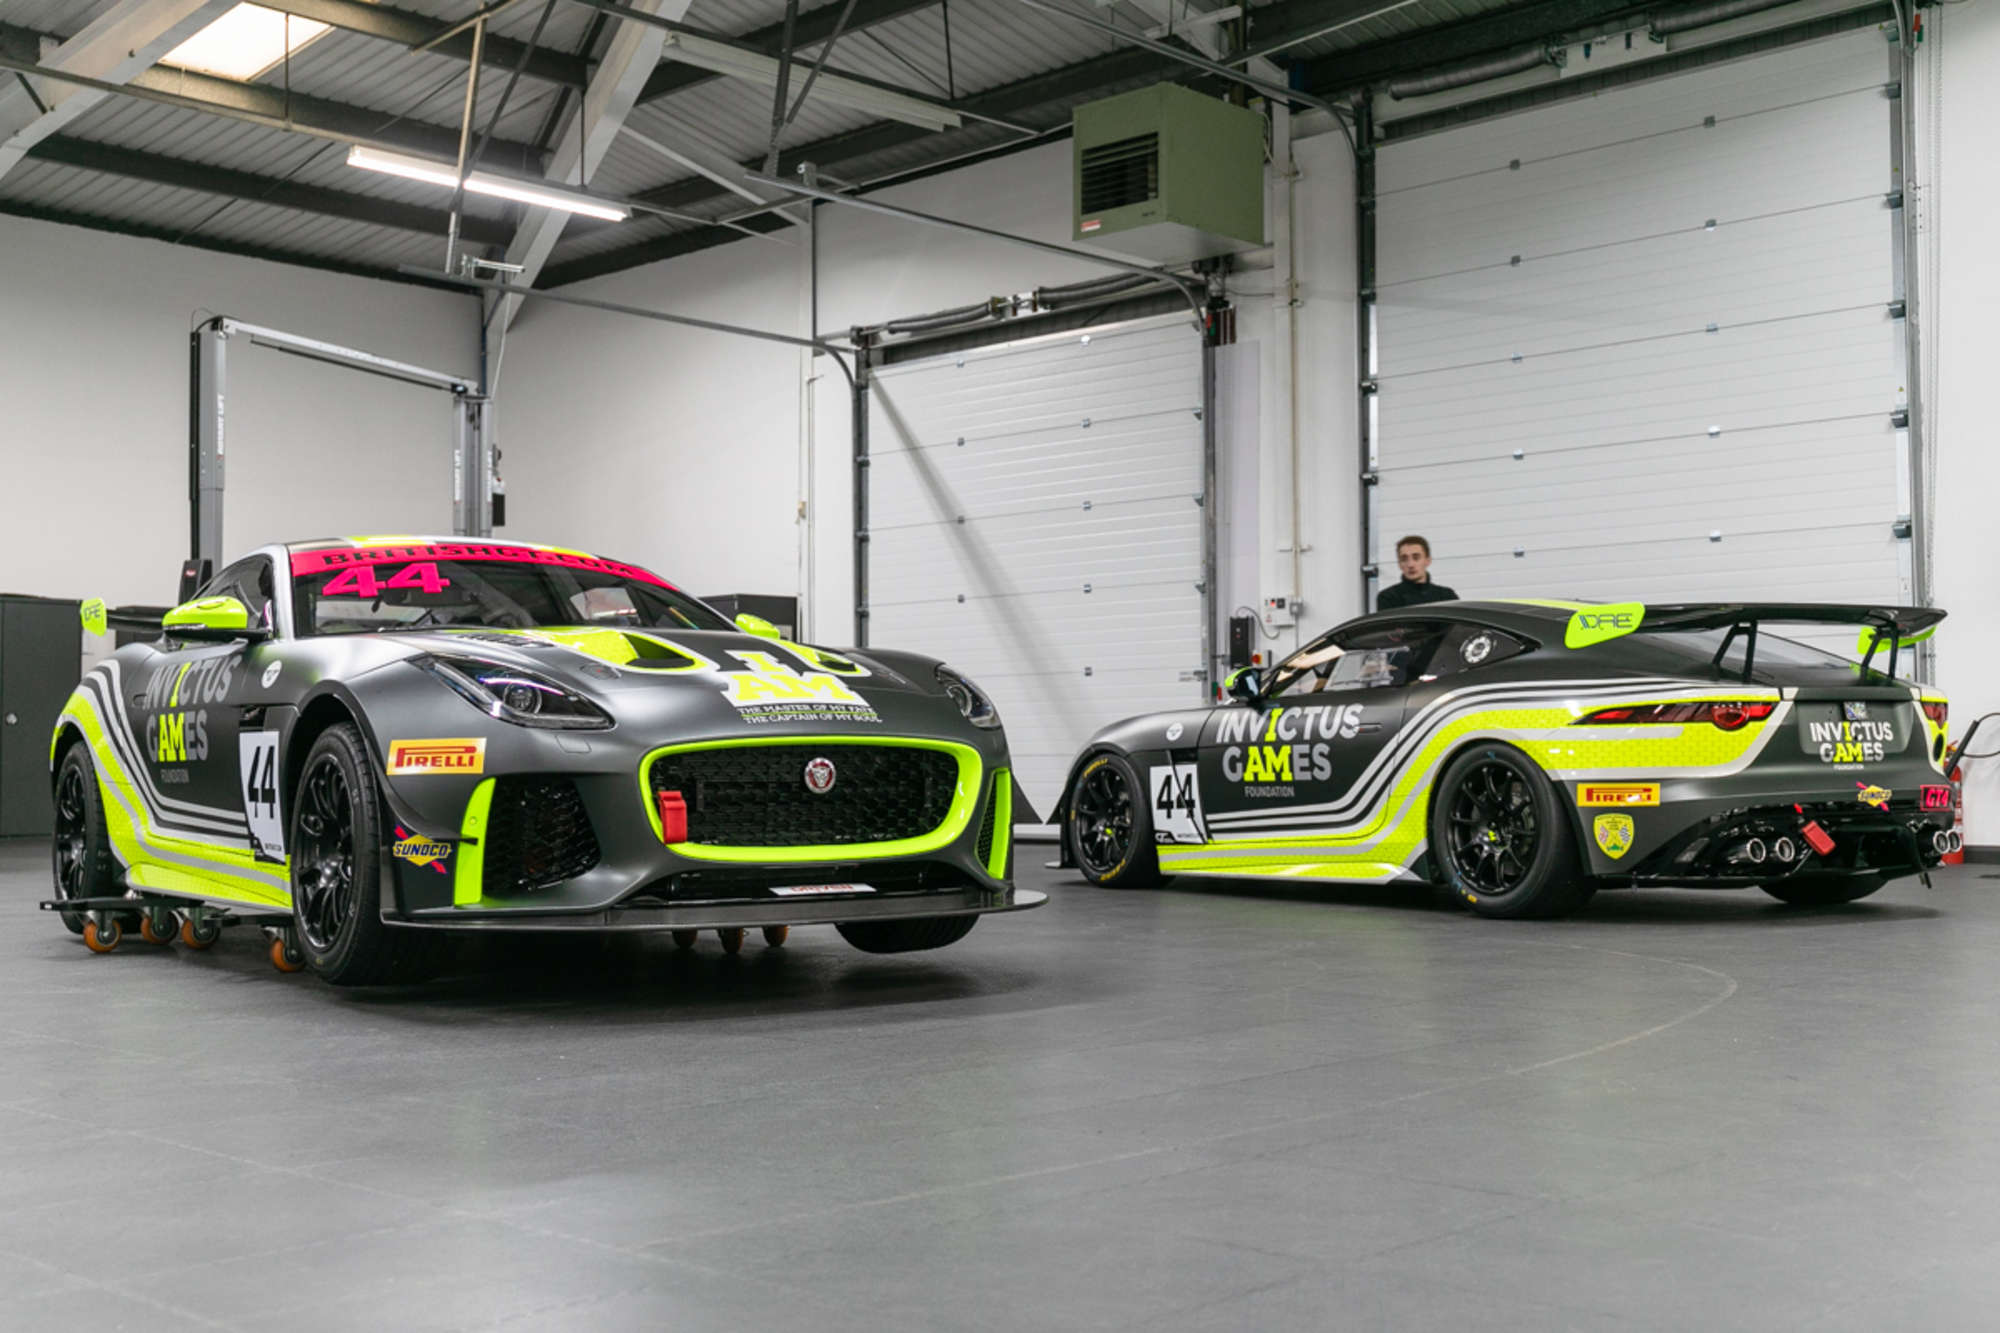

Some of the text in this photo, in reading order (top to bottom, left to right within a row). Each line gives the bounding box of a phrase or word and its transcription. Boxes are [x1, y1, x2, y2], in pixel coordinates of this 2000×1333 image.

[322, 562, 450, 598] 44
[142, 654, 242, 710] INVICTUS
[730, 673, 856, 700] AM
[146, 709, 208, 763] GAMES
[1216, 703, 1364, 743] INVICTUS
[1810, 721, 1894, 742] INVICTUS
[395, 746, 477, 768] PIRELLI
[1222, 742, 1332, 782] GAMES
[1819, 742, 1884, 763] GAMES
[248, 745, 276, 819] 44
[1244, 785, 1295, 797] FOUNDATION
[1586, 788, 1652, 802] PIREI
[1156, 773, 1196, 819] 44
[1925, 788, 1949, 808] GT4
[394, 843, 448, 857] SUNOCO
